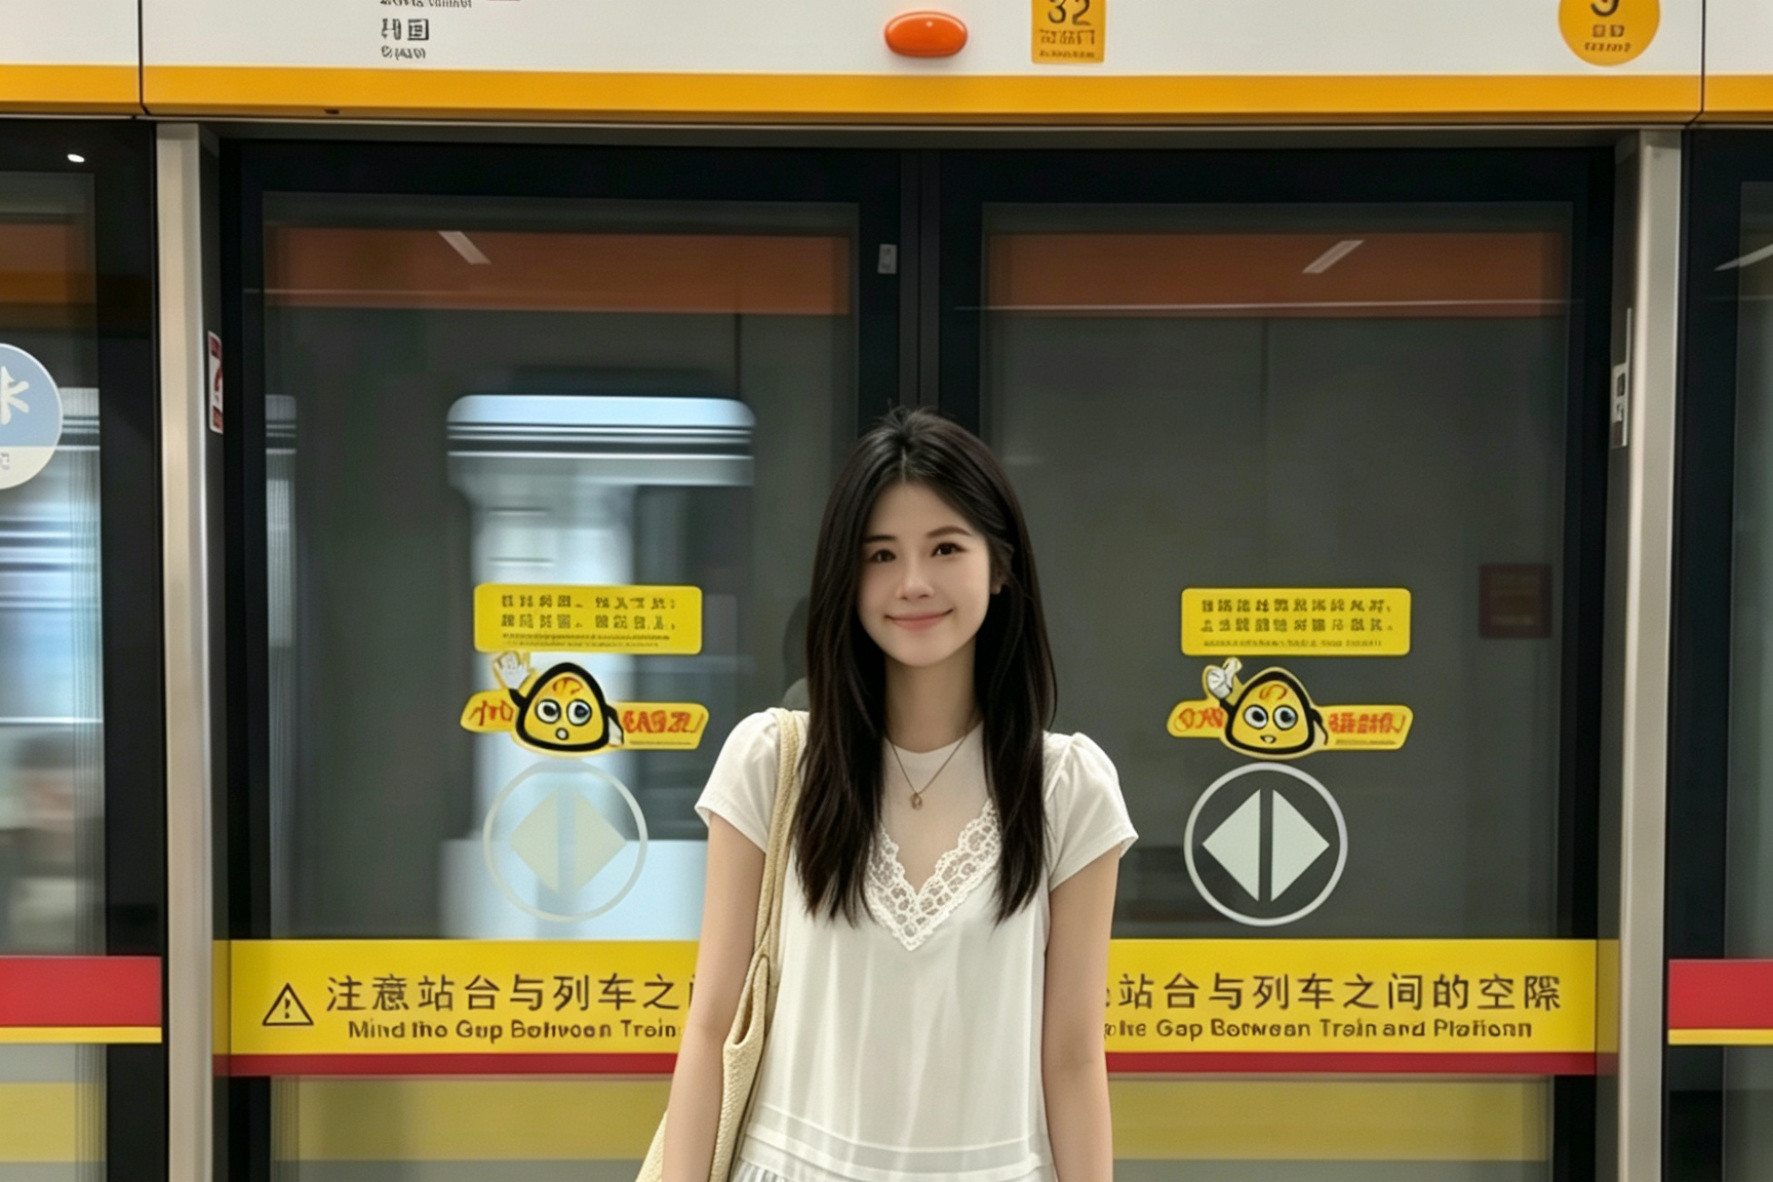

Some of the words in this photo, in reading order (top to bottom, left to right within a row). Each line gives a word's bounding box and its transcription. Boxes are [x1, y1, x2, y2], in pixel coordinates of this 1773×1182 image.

[326, 973, 695, 1012] 注意站台与列车之
[1156, 1018, 1203, 1043] Gap
